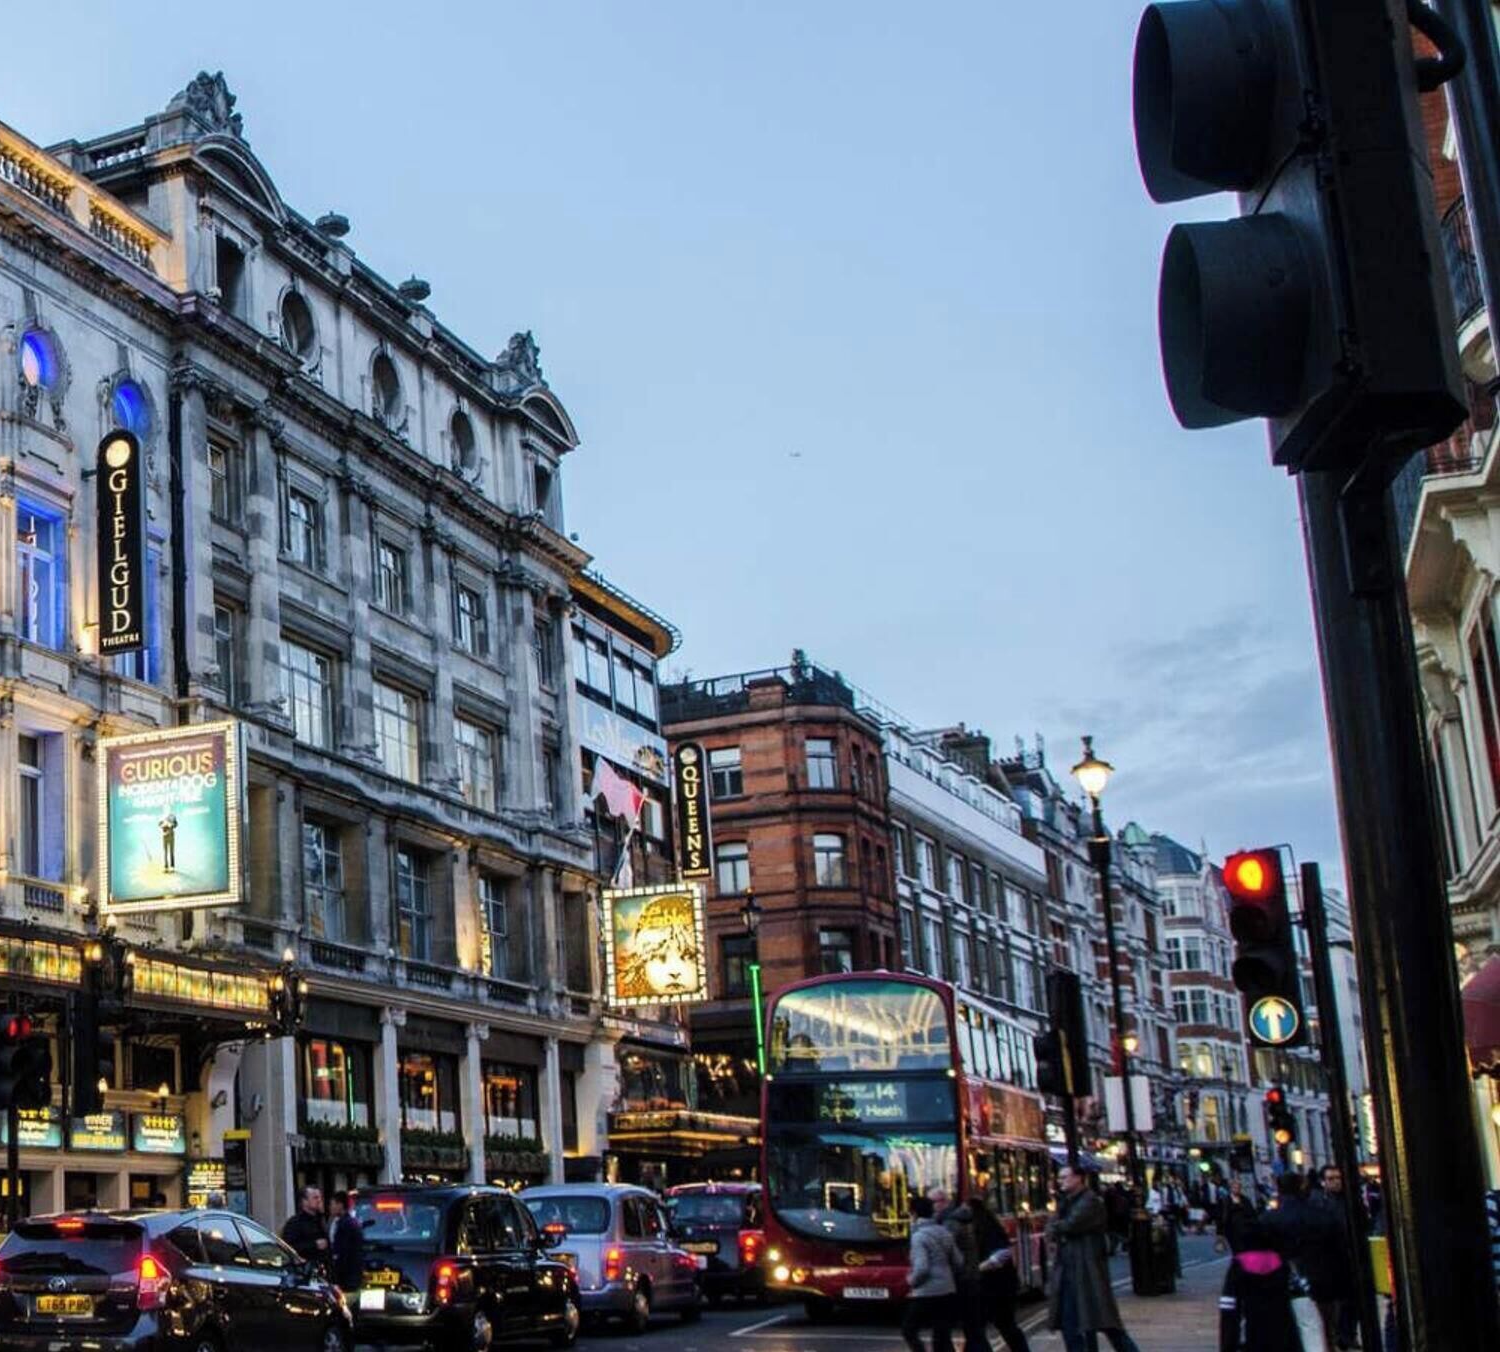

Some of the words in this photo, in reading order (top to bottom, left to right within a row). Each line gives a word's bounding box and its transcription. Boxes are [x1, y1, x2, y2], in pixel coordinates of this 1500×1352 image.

[109, 470, 132, 633] GIELGUD
[121, 751, 213, 783] CURIOUS
[179, 772, 217, 792] DOG
[682, 766, 701, 868] QUEENS
[876, 1083, 898, 1100] 14
